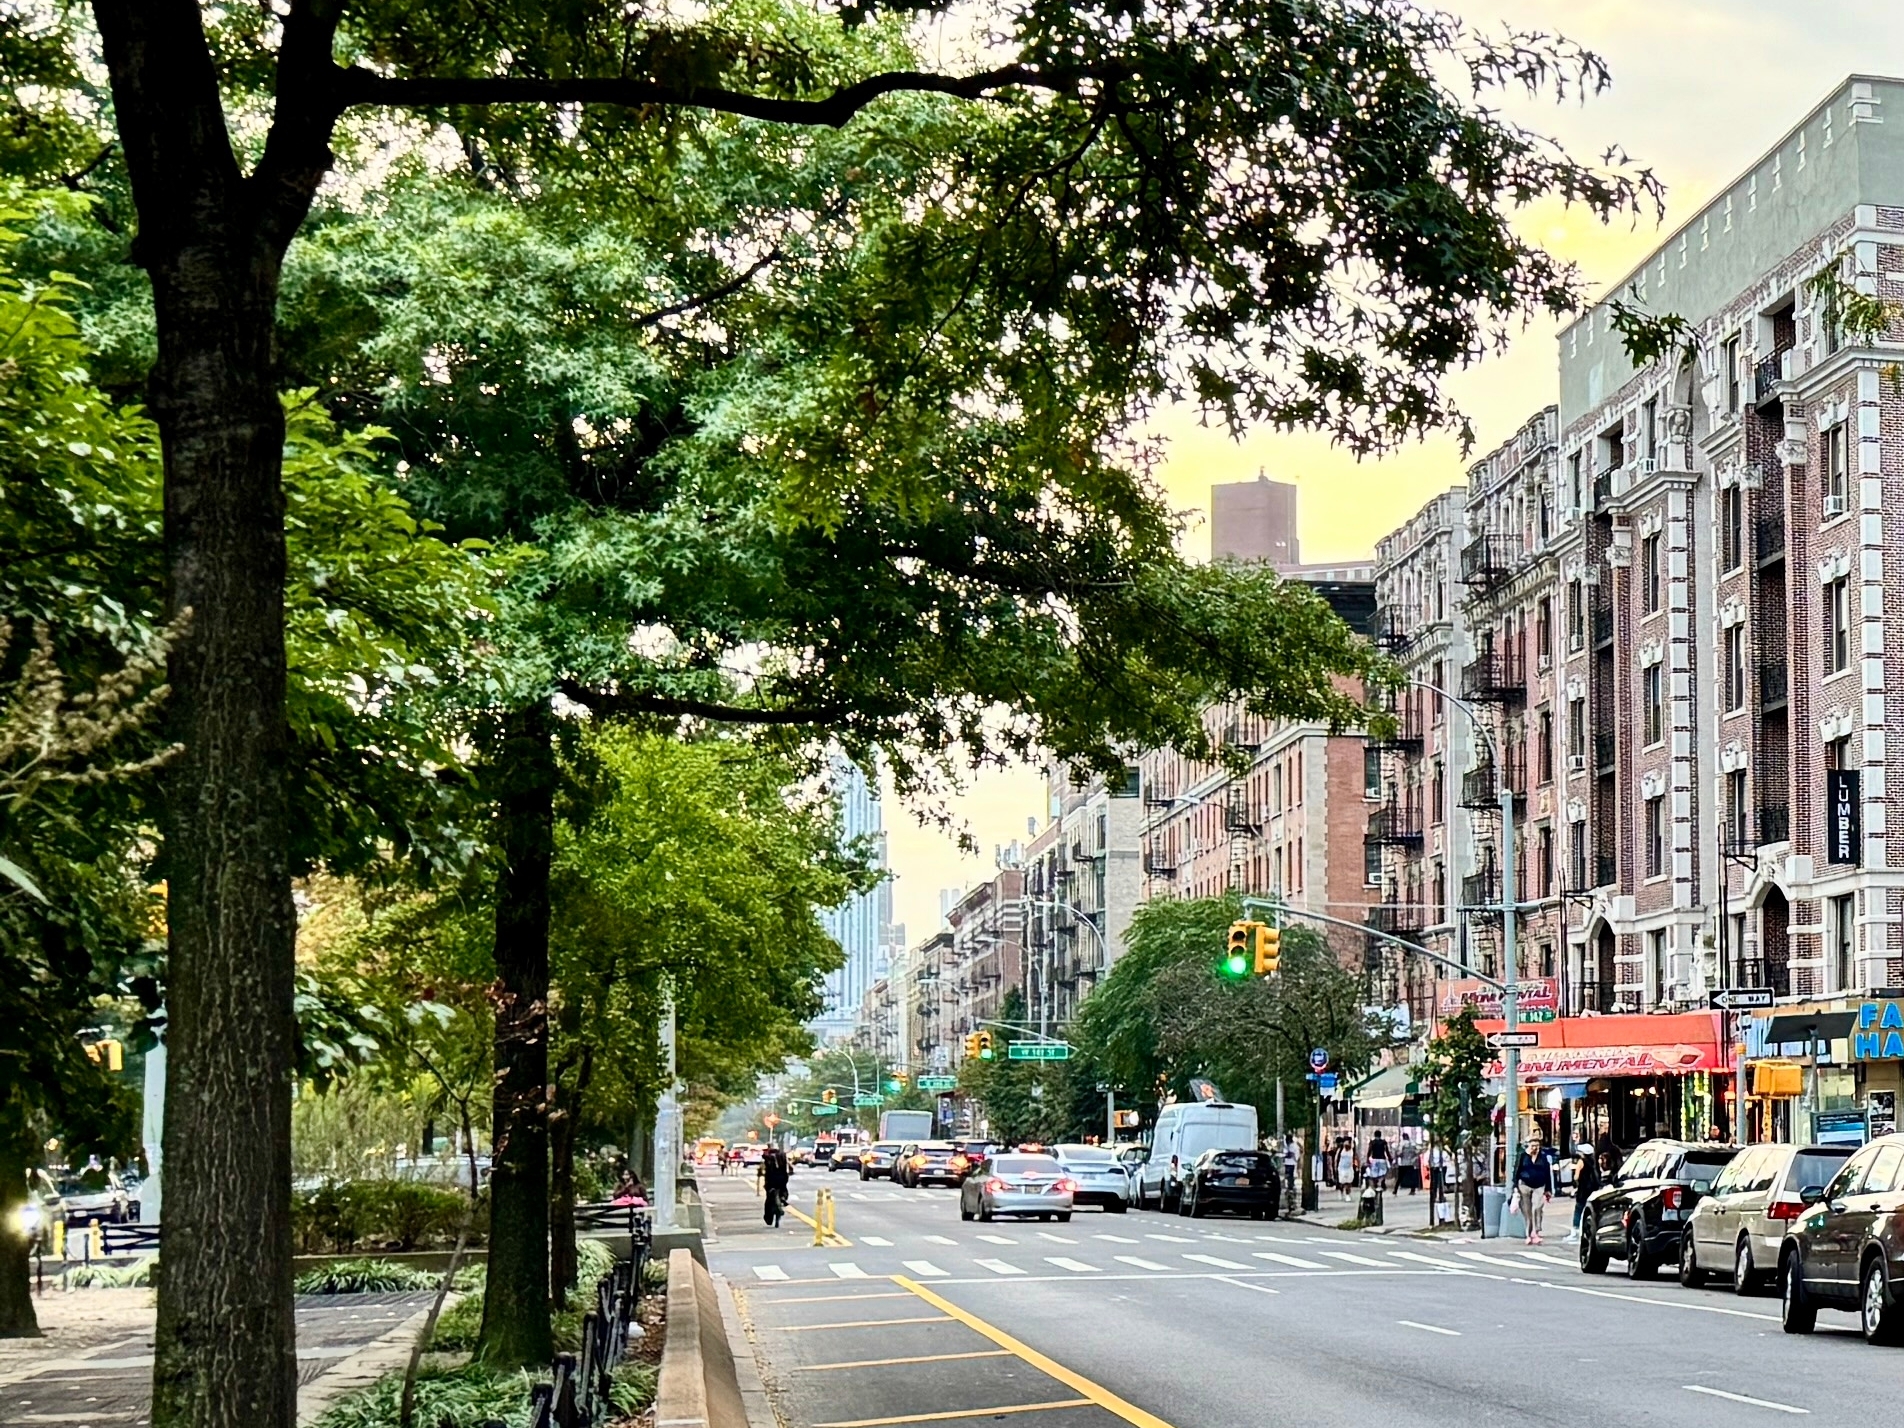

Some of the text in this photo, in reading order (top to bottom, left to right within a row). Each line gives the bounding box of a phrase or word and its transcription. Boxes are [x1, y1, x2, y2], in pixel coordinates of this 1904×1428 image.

[1837, 775, 1851, 859] LUMBER
[1721, 993, 1767, 1005] ONE WAY
